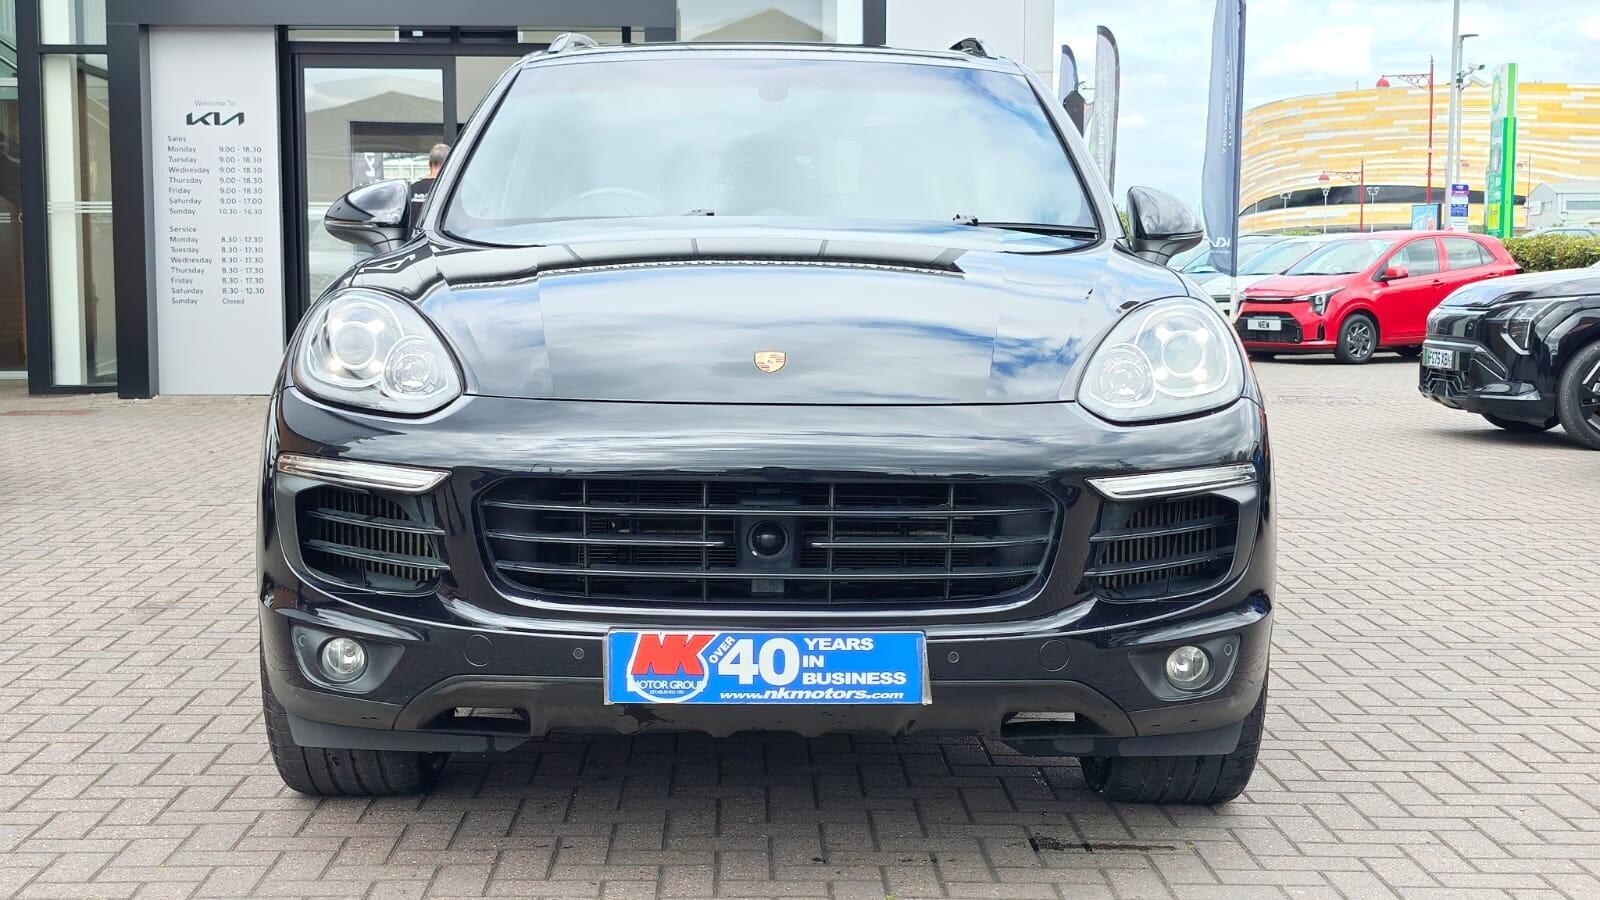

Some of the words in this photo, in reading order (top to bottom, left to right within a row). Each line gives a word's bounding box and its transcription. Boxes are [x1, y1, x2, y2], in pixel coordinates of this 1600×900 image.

[186, 112, 244, 126] KIA
[169, 187, 191, 195] Friday
[170, 236, 198, 244] Monday
[171, 277, 193, 285] Friday
[1257, 321, 1270, 329] NEW
[709, 636, 736, 664] OVER
[803, 637, 874, 651] YEARS
[717, 638, 800, 686] 40
[803, 655, 824, 668] IN
[802, 672, 907, 686] BUSINESS
[720, 688, 904, 700] www.nkmotors.com
